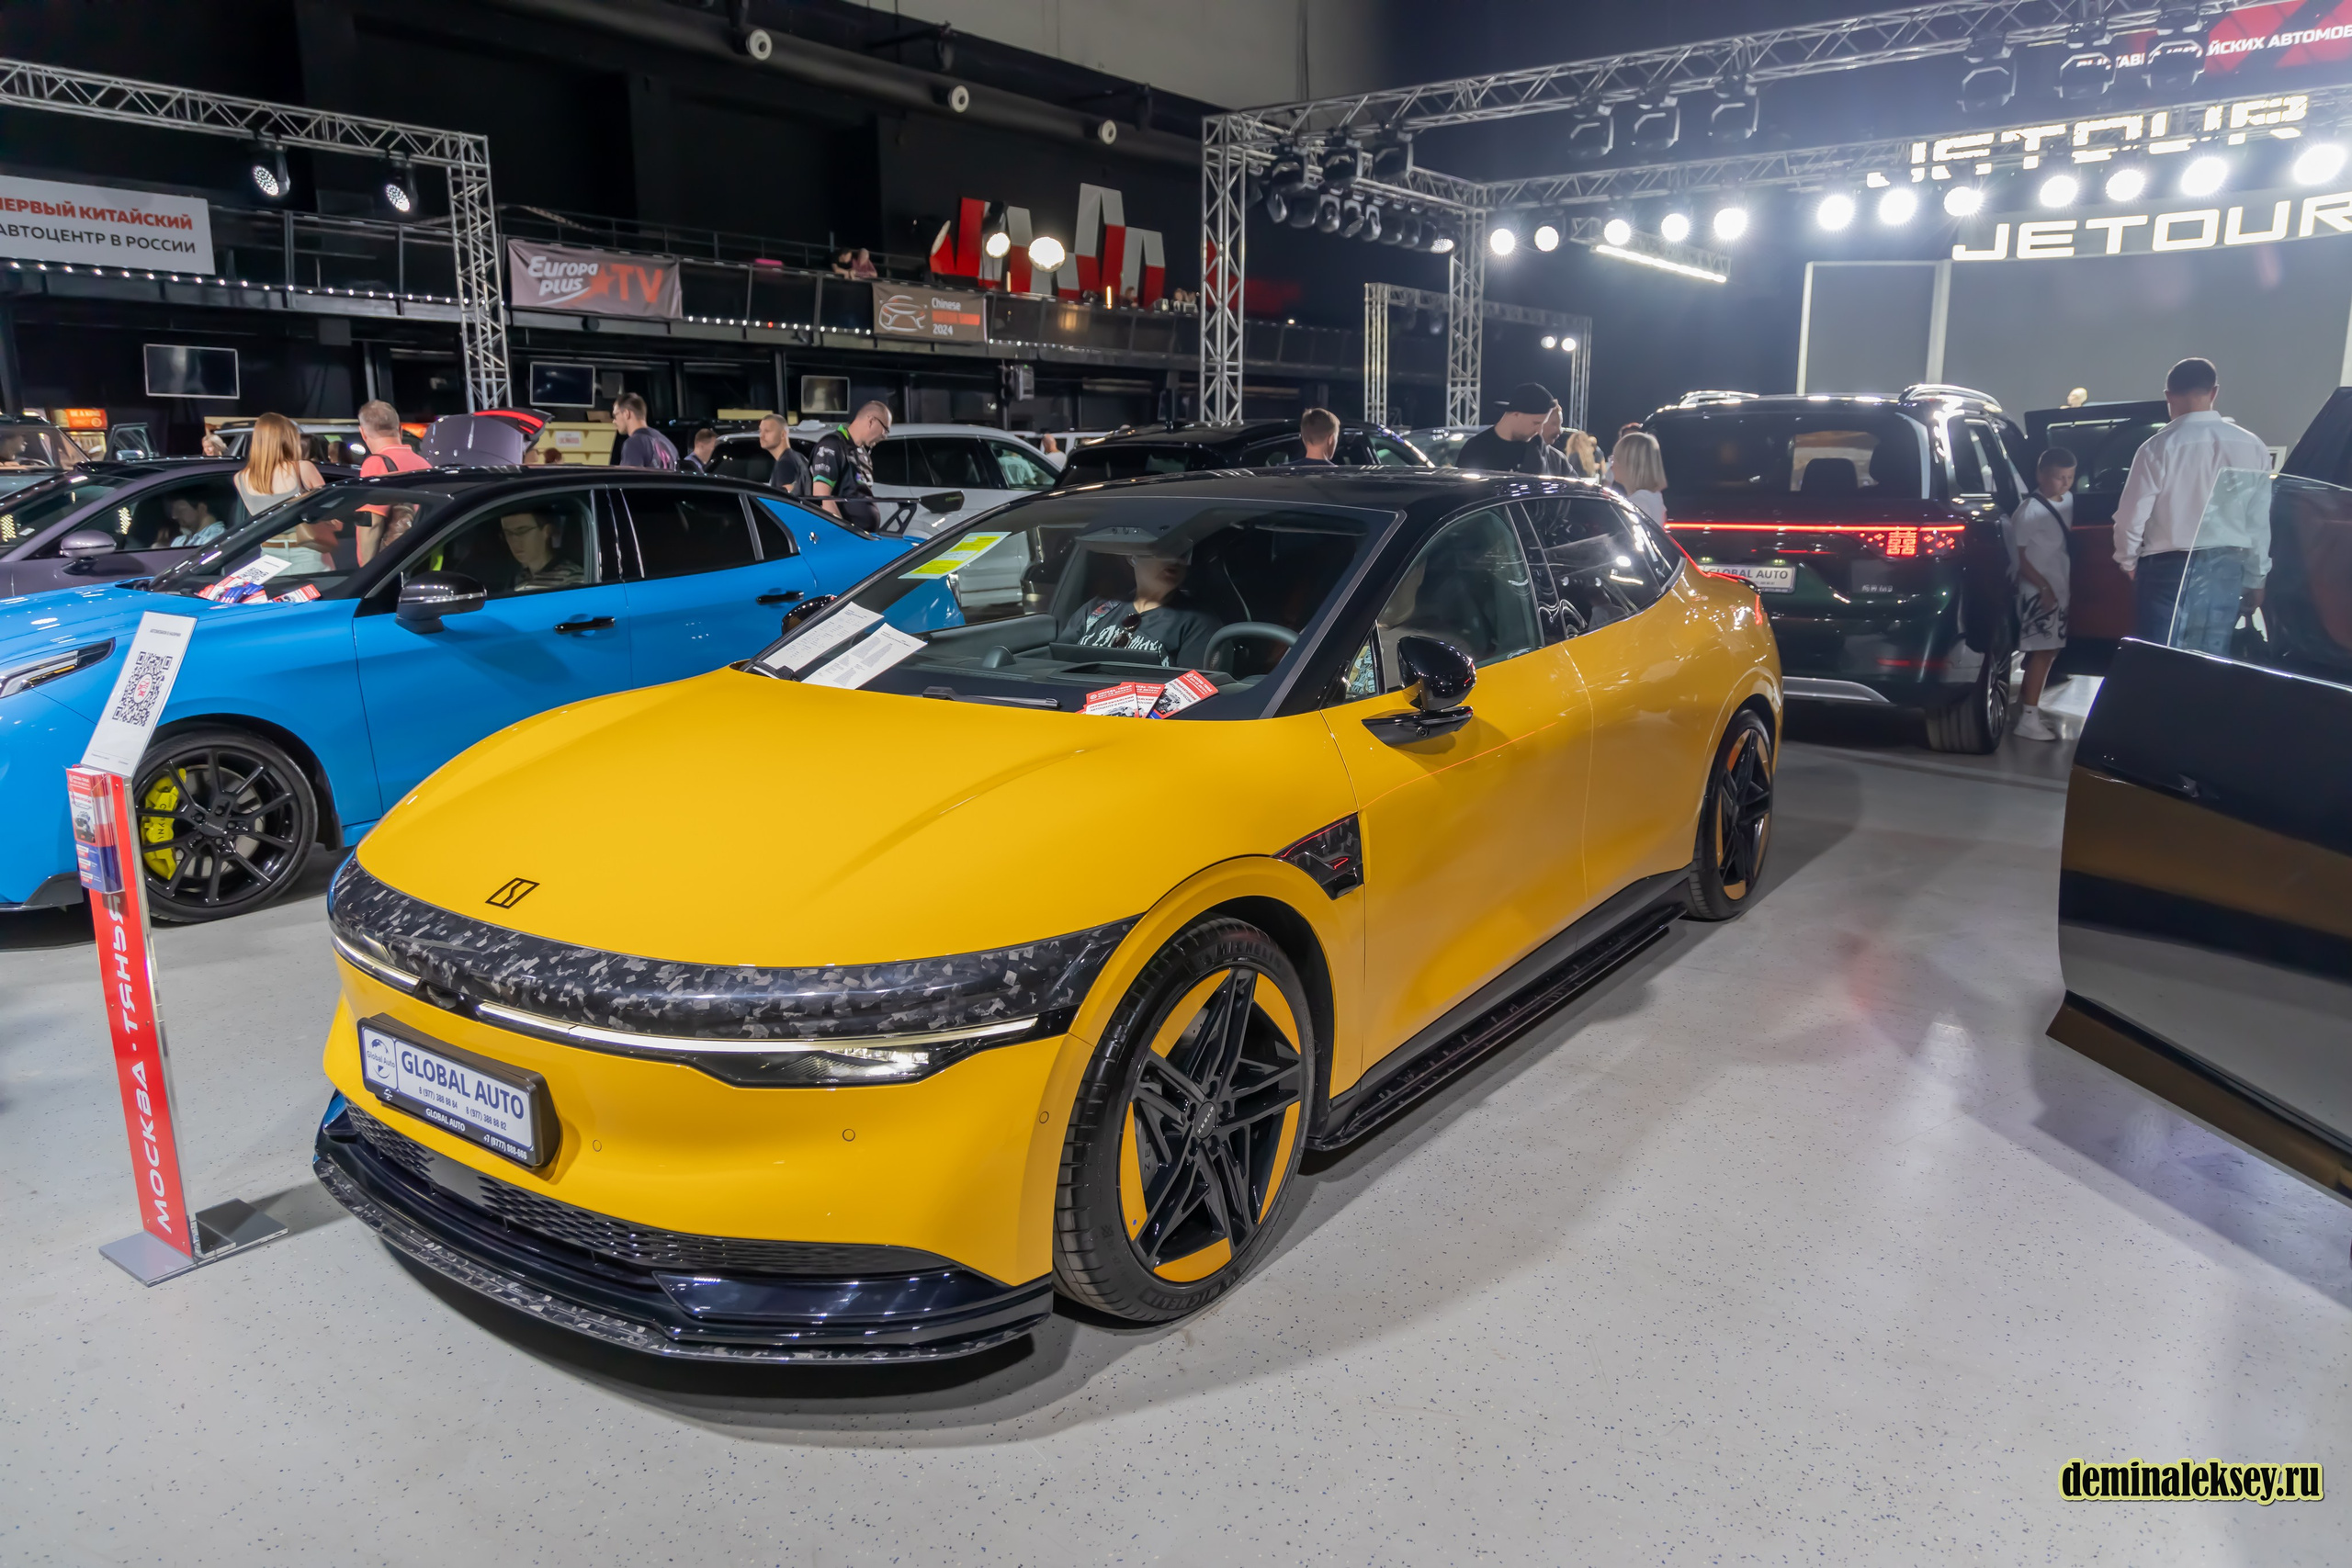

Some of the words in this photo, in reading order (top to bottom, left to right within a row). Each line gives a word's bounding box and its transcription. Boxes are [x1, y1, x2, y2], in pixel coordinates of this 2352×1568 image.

[80, 206, 193, 231] КИТАЙСКИЙ
[1952, 191, 2352, 261] JETOUR
[111, 234, 122, 246] В
[126, 236, 196, 254] РОССИИ
[527, 255, 599, 277] Europa
[538, 277, 584, 297] plus
[610, 263, 664, 304] TV
[931, 297, 962, 311] Chinese
[933, 323, 954, 335] 2024
[1756, 570, 1788, 580] AUTO
[401, 1051, 470, 1098] GLOBAL
[475, 1080, 525, 1119] AUTO
[425, 1108, 449, 1125] GLOBAL
[449, 1120, 466, 1132] AUTO
[1197, 1106, 1215, 1134] ZEEKR
[131, 1060, 173, 1235] МОСКВА
